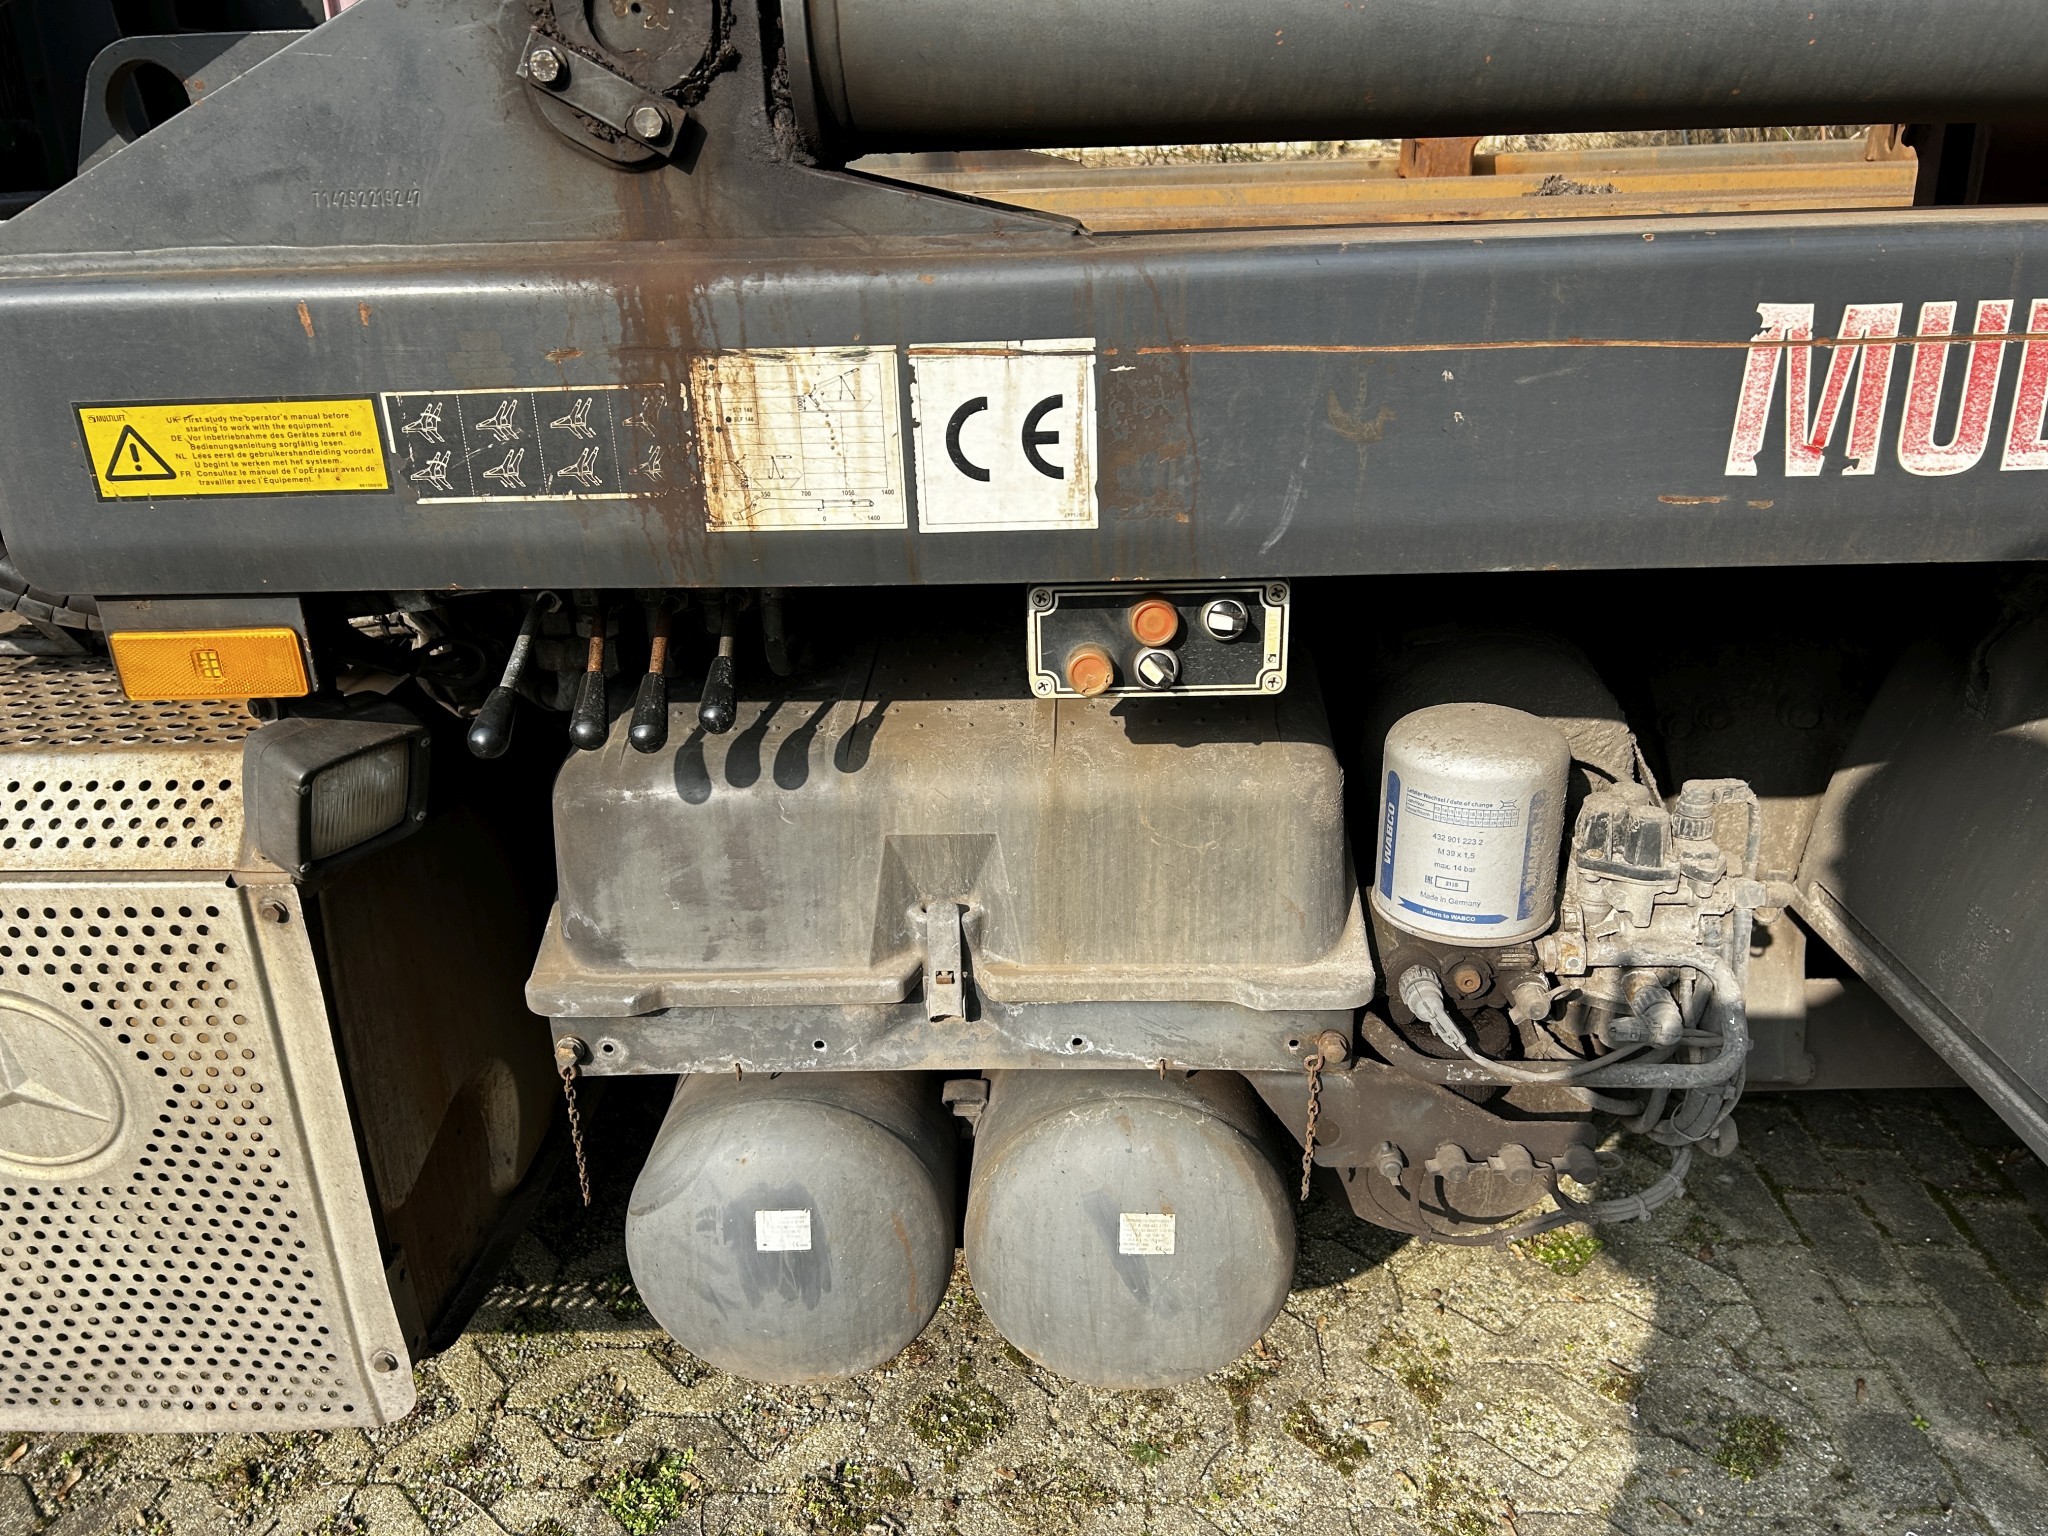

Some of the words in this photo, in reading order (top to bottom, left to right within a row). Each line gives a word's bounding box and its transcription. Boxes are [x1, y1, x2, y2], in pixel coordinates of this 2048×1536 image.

[183, 415, 203, 423] First
[205, 416, 227, 424] study
[246, 413, 288, 423] operator's
[186, 425, 218, 433] starting
[287, 431, 319, 439] Gerätes
[190, 442, 277, 451] Bedienungsanleitung
[279, 440, 319, 448] sorgfältig
[203, 461, 229, 469] begint
[199, 478, 235, 486] travailler
[1384, 802, 1396, 865] WABCO
[1432, 833, 1445, 841] 432
[1434, 862, 1450, 870] max.
[1420, 891, 1439, 901] Made
[1448, 897, 1481, 908] Germany
[1422, 908, 1441, 918] Return
